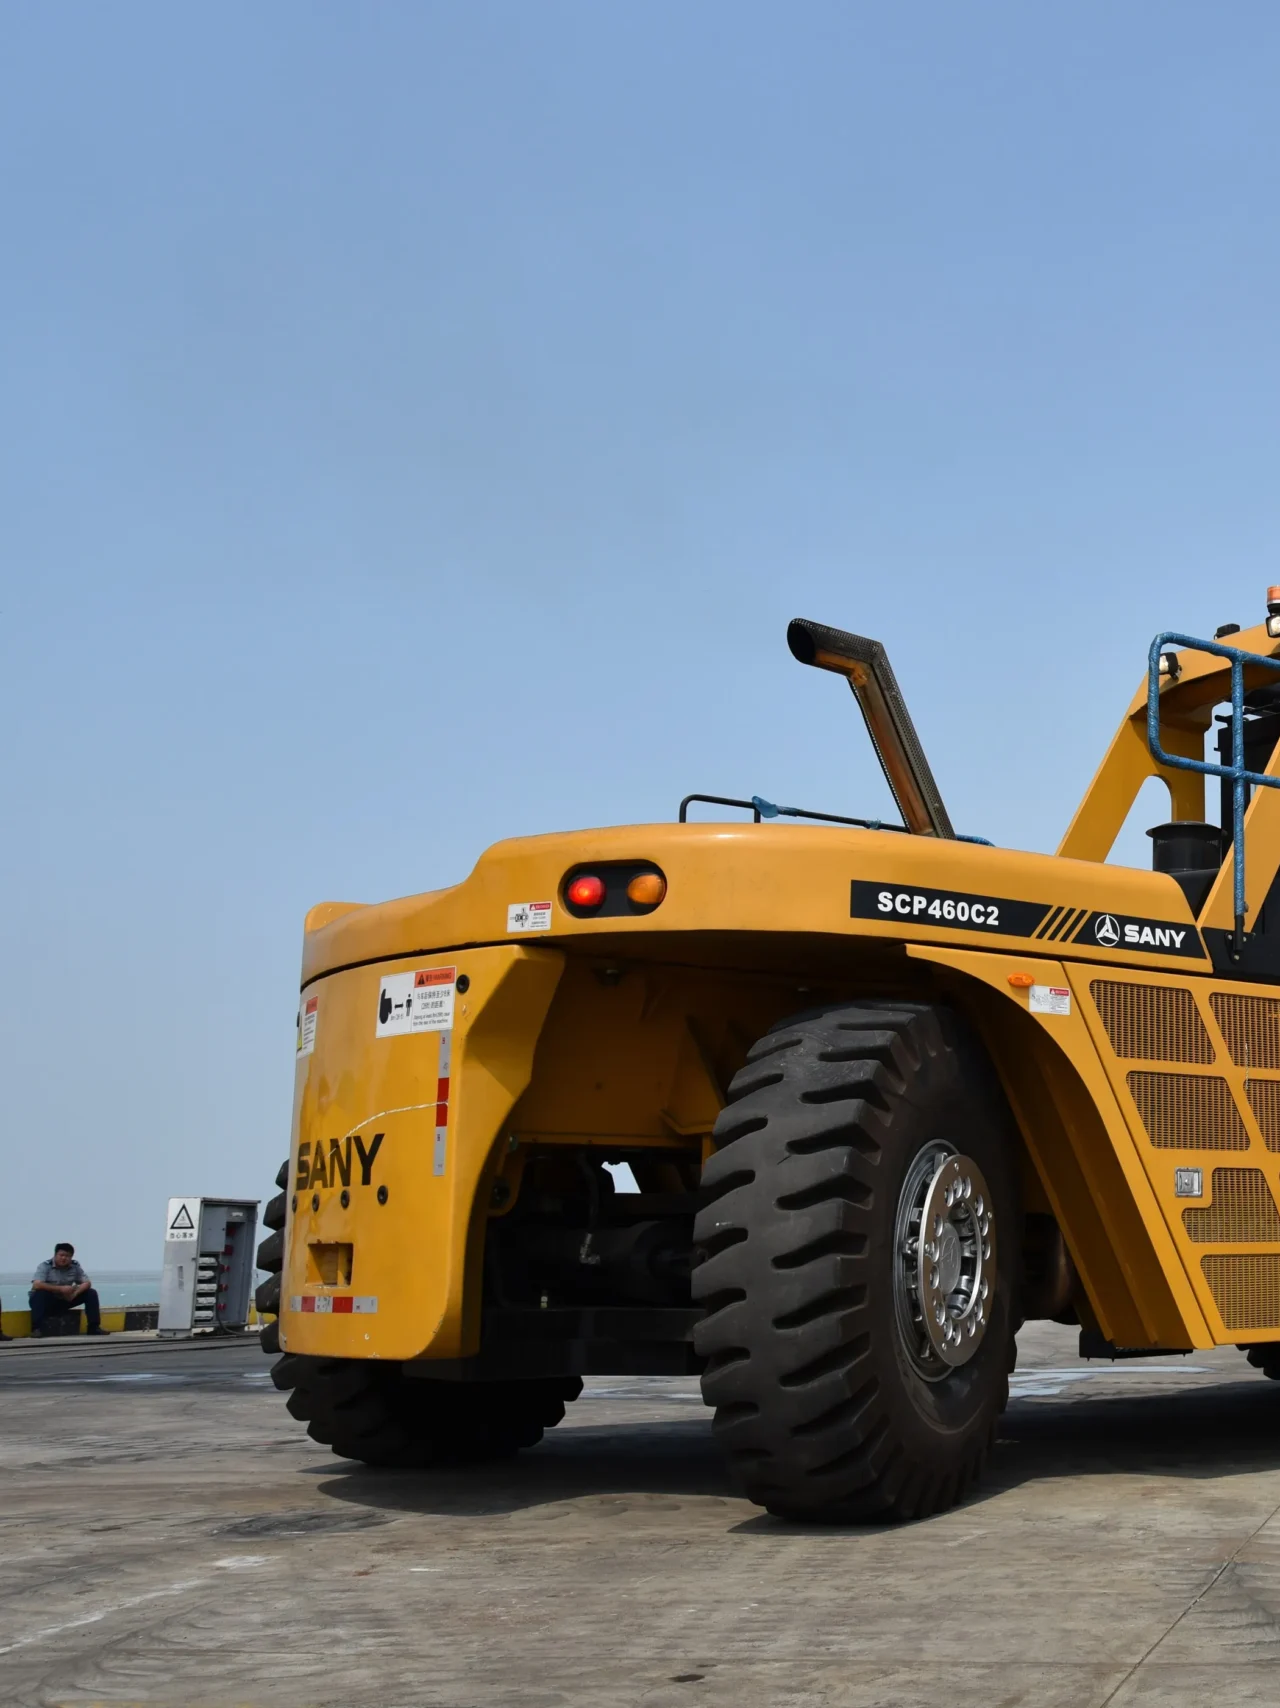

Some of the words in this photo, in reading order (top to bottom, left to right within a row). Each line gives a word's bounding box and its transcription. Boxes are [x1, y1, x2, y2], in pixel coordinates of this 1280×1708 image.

[877, 891, 1000, 926] SCP460C2
[1124, 925, 1186, 949] SANY
[295, 1133, 386, 1191] SANY
